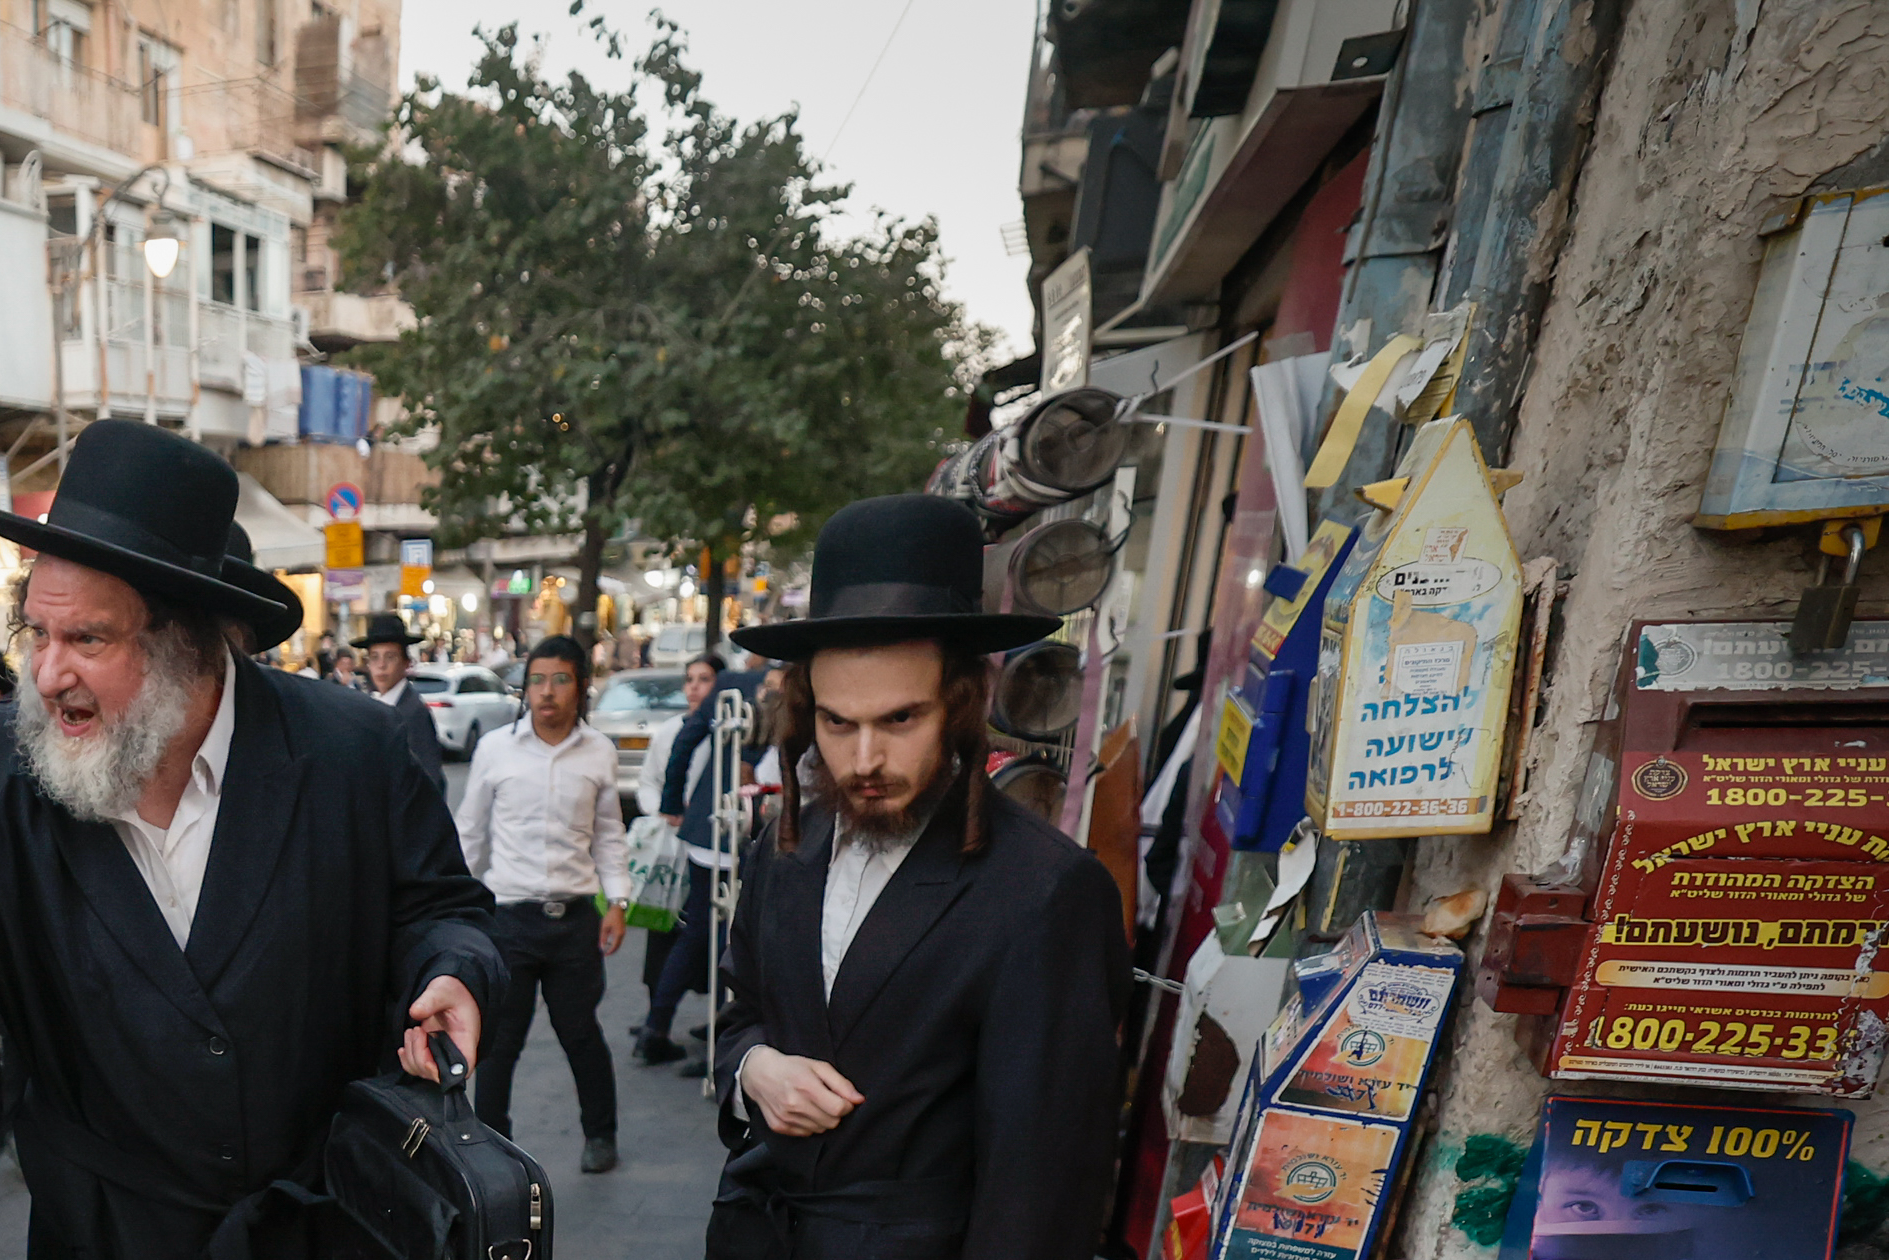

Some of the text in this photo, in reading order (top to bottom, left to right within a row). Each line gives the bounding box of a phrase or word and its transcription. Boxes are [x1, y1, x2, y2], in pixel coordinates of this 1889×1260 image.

[1702, 754, 1887, 775] עניי ארץ ישראל
[1348, 757, 1453, 790] לרפואה
[1749, 775, 1773, 784] הדור
[1813, 774, 1841, 784] גדולי
[1844, 775, 1862, 784] של
[1336, 799, 1469, 817] 1-800-22-36-36
[1735, 820, 1797, 844] ארץ
[1803, 821, 1864, 846] עניי
[1631, 828, 1727, 875] ישראל
[1670, 871, 1876, 892] הצדקה המהודרת
[1727, 890, 1756, 899] הדור
[1759, 891, 1804, 901] ומאורי
[1808, 892, 1842, 902] גדולי
[1845, 893, 1867, 903] של
[1615, 915, 1759, 945] נושעתם!
[1617, 964, 1655, 973] האישית
[1697, 966, 1725, 977] ולצרף
[1726, 967, 1760, 977] תרומות
[1762, 968, 1795, 979] להעביר
[1799, 970, 1823, 980] ניתן
[1692, 977, 1711, 986] הדור
[1746, 979, 1770, 989] גדולי
[1788, 981, 1826, 991] לתפילה
[1623, 1002, 1838, 1022] לתרומות בכרטיס אשראי חייגו כעת:
[1572, 1118, 1815, 1163] 100% צדקה
